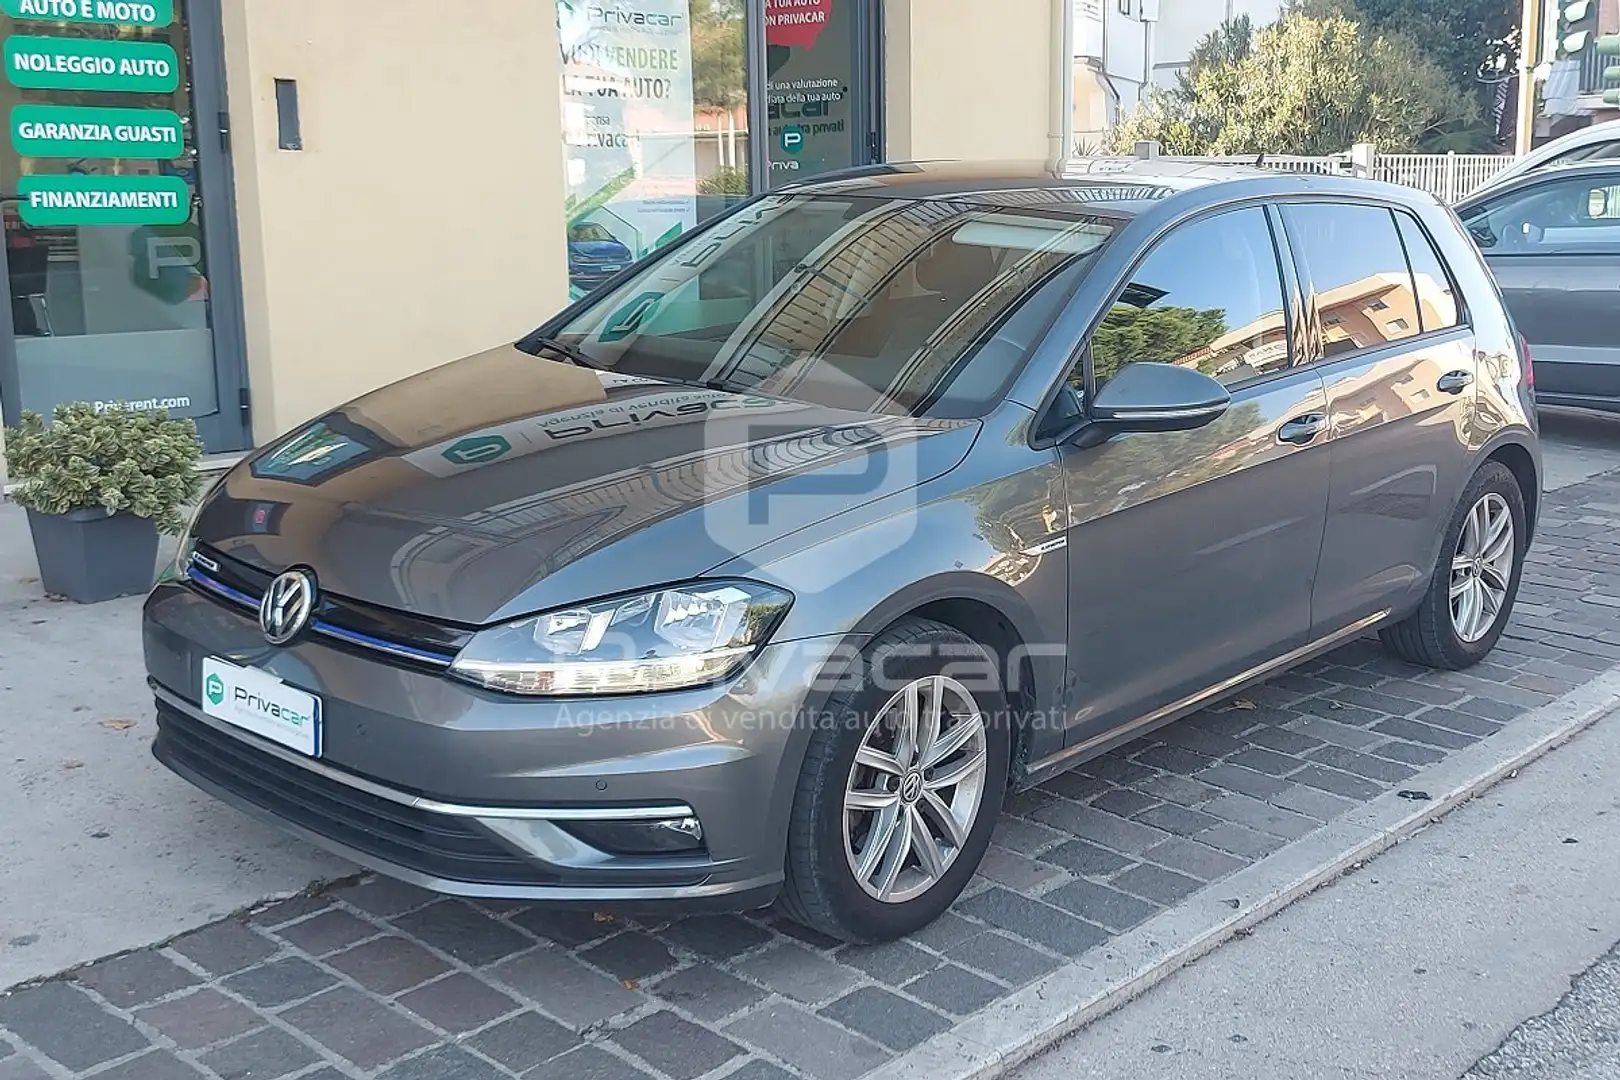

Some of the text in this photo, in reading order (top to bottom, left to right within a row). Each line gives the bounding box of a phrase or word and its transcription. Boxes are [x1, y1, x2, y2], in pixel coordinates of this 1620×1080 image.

[20, 0, 157, 22] AUTO E MOTO
[587, 6, 683, 27] Privacar
[764, 11, 825, 26] ON PRIVACAR
[13, 52, 170, 78] NOLEGGIO AUTO
[775, 82, 791, 91] una
[791, 78, 839, 90] valutazione
[786, 92, 806, 103] della
[807, 92, 821, 102] tua
[821, 91, 841, 101] auto
[18, 122, 177, 143] GARANZIA GUASTI
[30, 191, 178, 209] FINANZIAMENTI
[233, 686, 310, 727] Privacar
